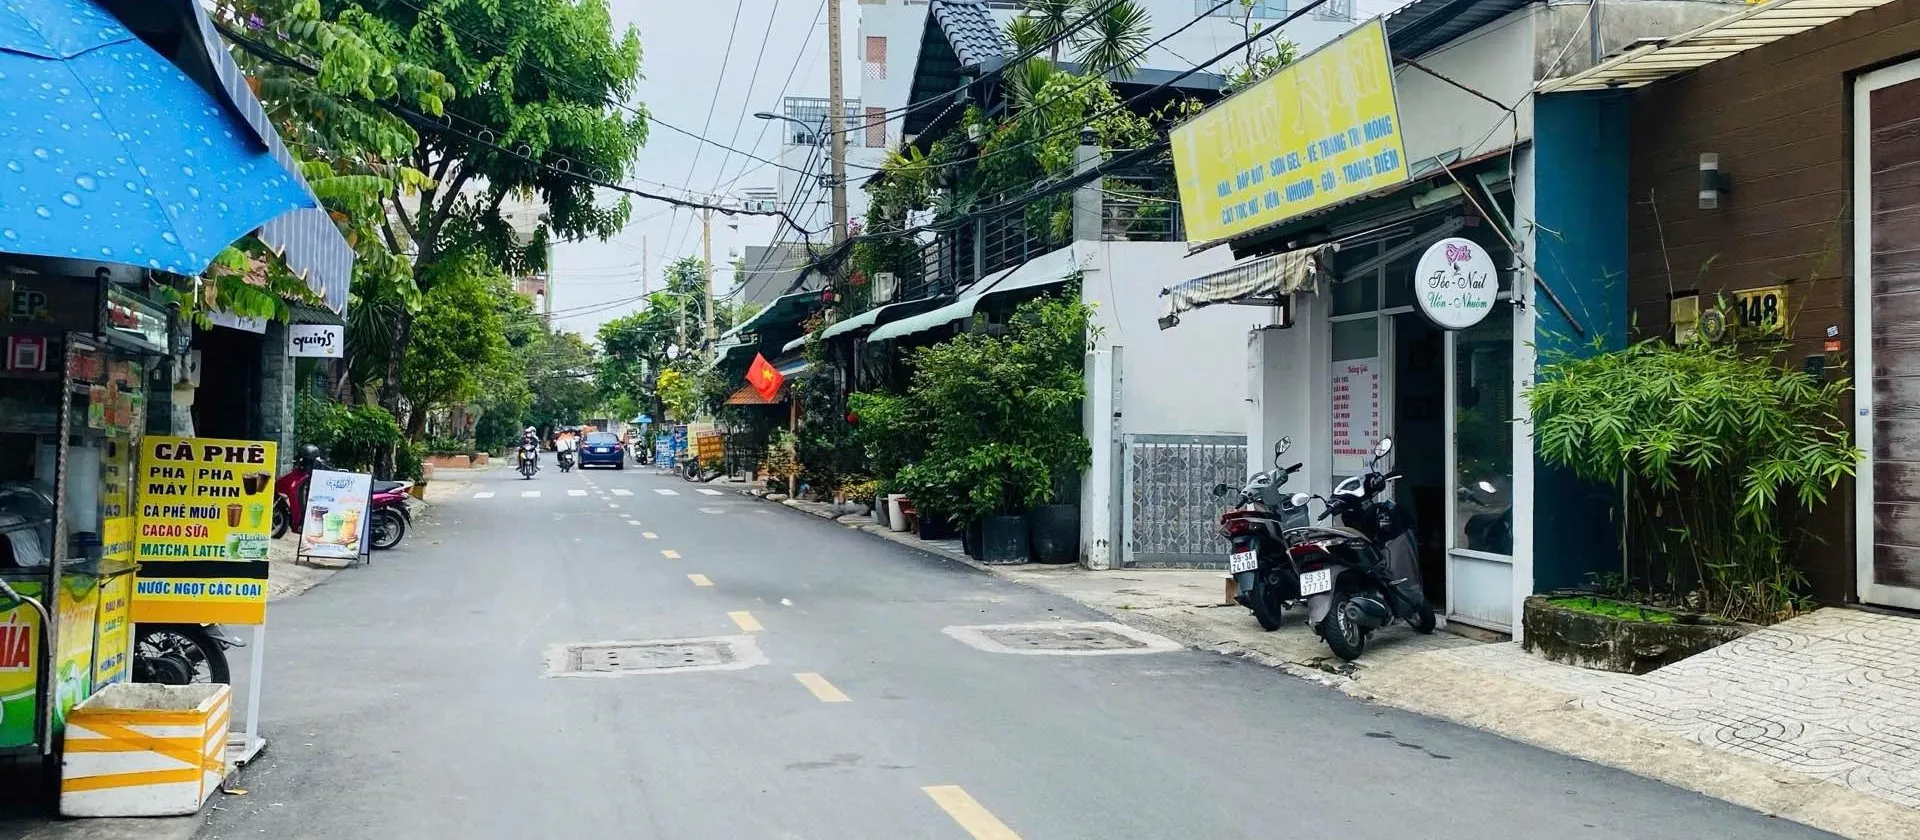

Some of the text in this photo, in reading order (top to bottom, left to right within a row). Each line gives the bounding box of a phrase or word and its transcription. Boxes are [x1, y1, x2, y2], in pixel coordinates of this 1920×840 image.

[1286, 152, 1302, 171] GEL
[1342, 159, 1373, 184] TRANG
[1740, 294, 1777, 327] 148
[155, 441, 264, 464] CÀ PHÊ
[150, 467, 185, 479] PHA
[199, 468, 233, 480] PHA
[148, 482, 187, 496] MÁY
[197, 485, 240, 497] PHIN
[142, 524, 182, 537] CACAO
[140, 543, 189, 556] MATCHA
[193, 544, 225, 558] LATTE
